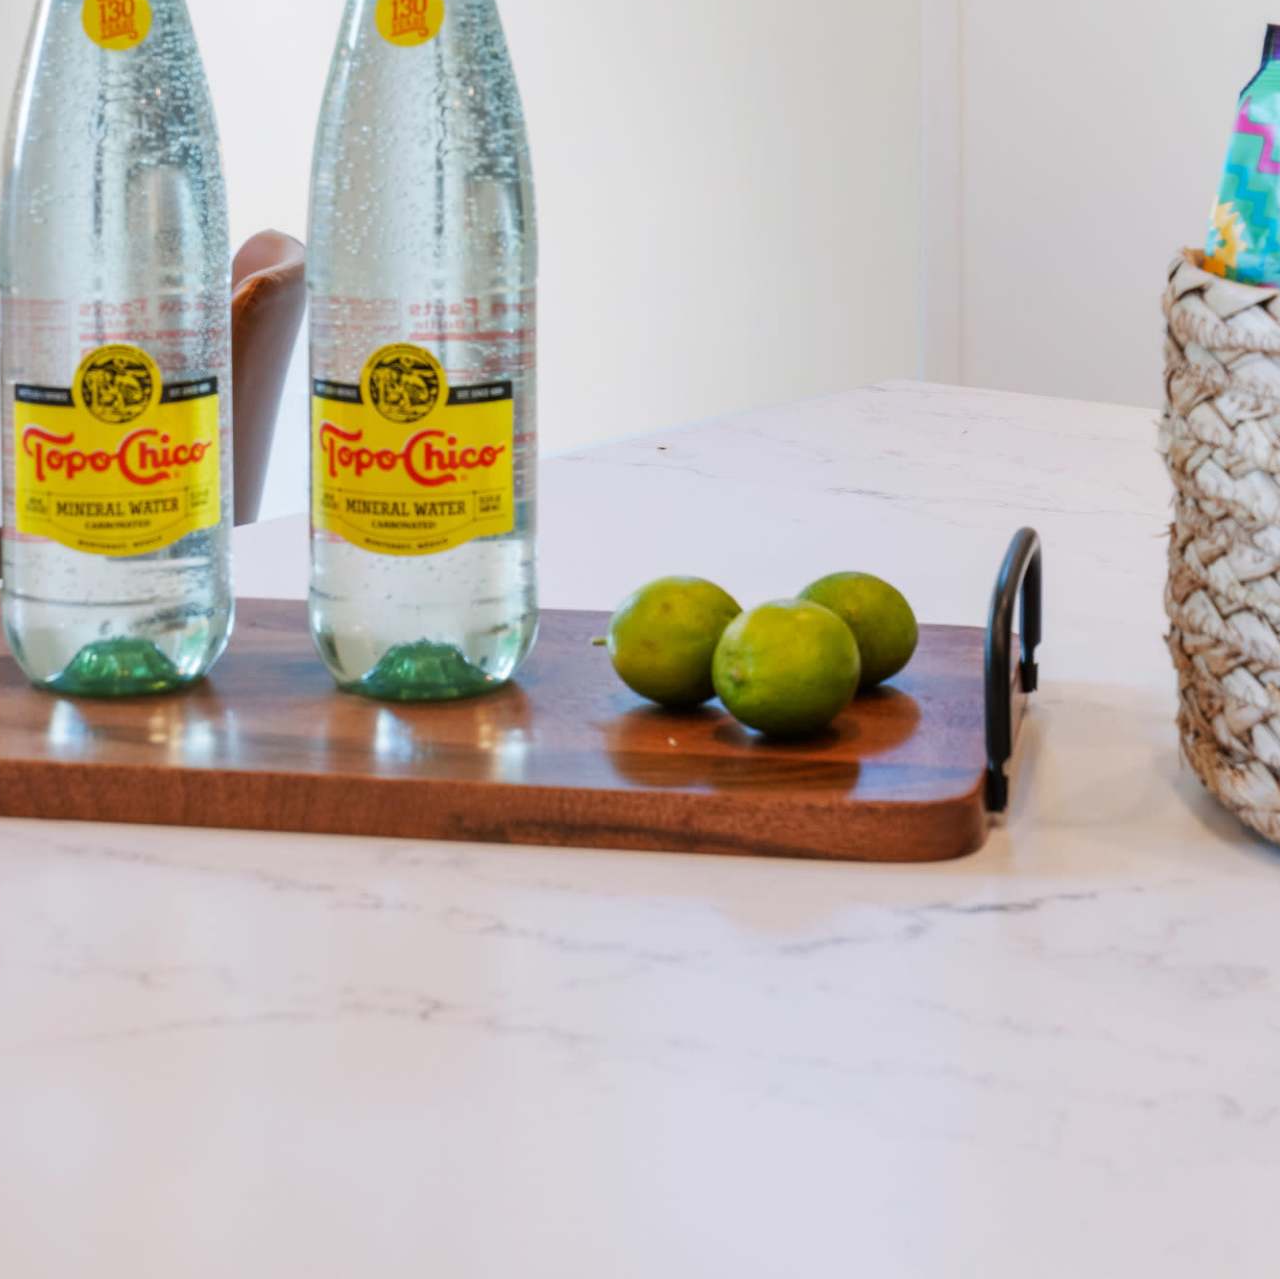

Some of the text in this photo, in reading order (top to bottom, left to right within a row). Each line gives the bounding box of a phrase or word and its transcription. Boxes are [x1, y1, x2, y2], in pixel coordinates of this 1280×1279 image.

[22, 426, 212, 486] Topo Chico
[320, 422, 506, 488] Topo Chico
[56, 499, 124, 517] MINERAL
[129, 497, 180, 515] WATER
[346, 498, 410, 517] MINERAL
[414, 500, 466, 516] WATER
